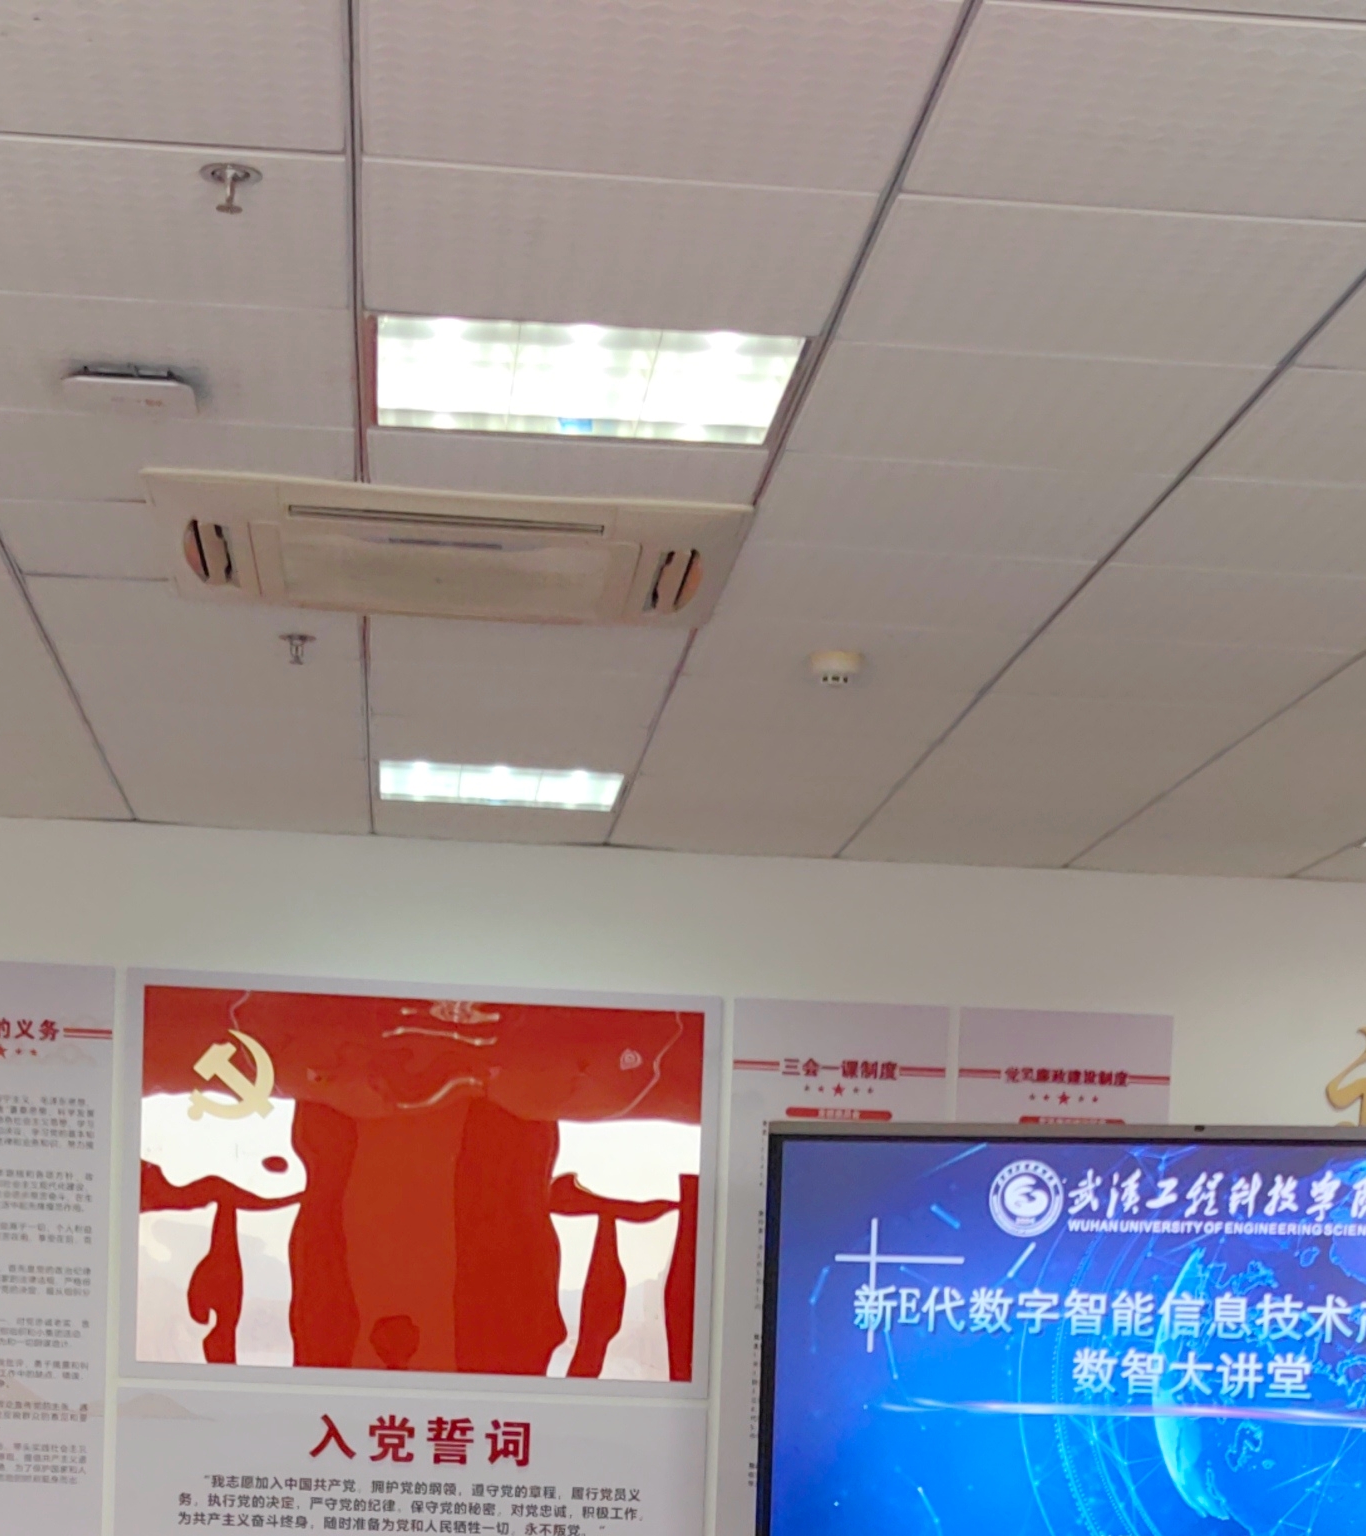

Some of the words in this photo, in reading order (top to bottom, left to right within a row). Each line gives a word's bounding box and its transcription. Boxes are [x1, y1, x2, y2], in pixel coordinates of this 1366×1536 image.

[781, 1057, 898, 1082] 三会一课制度
[1067, 1219, 1118, 1233] WUHAN
[1119, 1219, 1203, 1235] UNIVERSITY
[1203, 1221, 1224, 1235] OF
[1224, 1221, 1324, 1236] ENGINEERING
[1072, 1347, 1313, 1400] 数智大讲堂
[309, 1413, 533, 1467] 入党誓词
